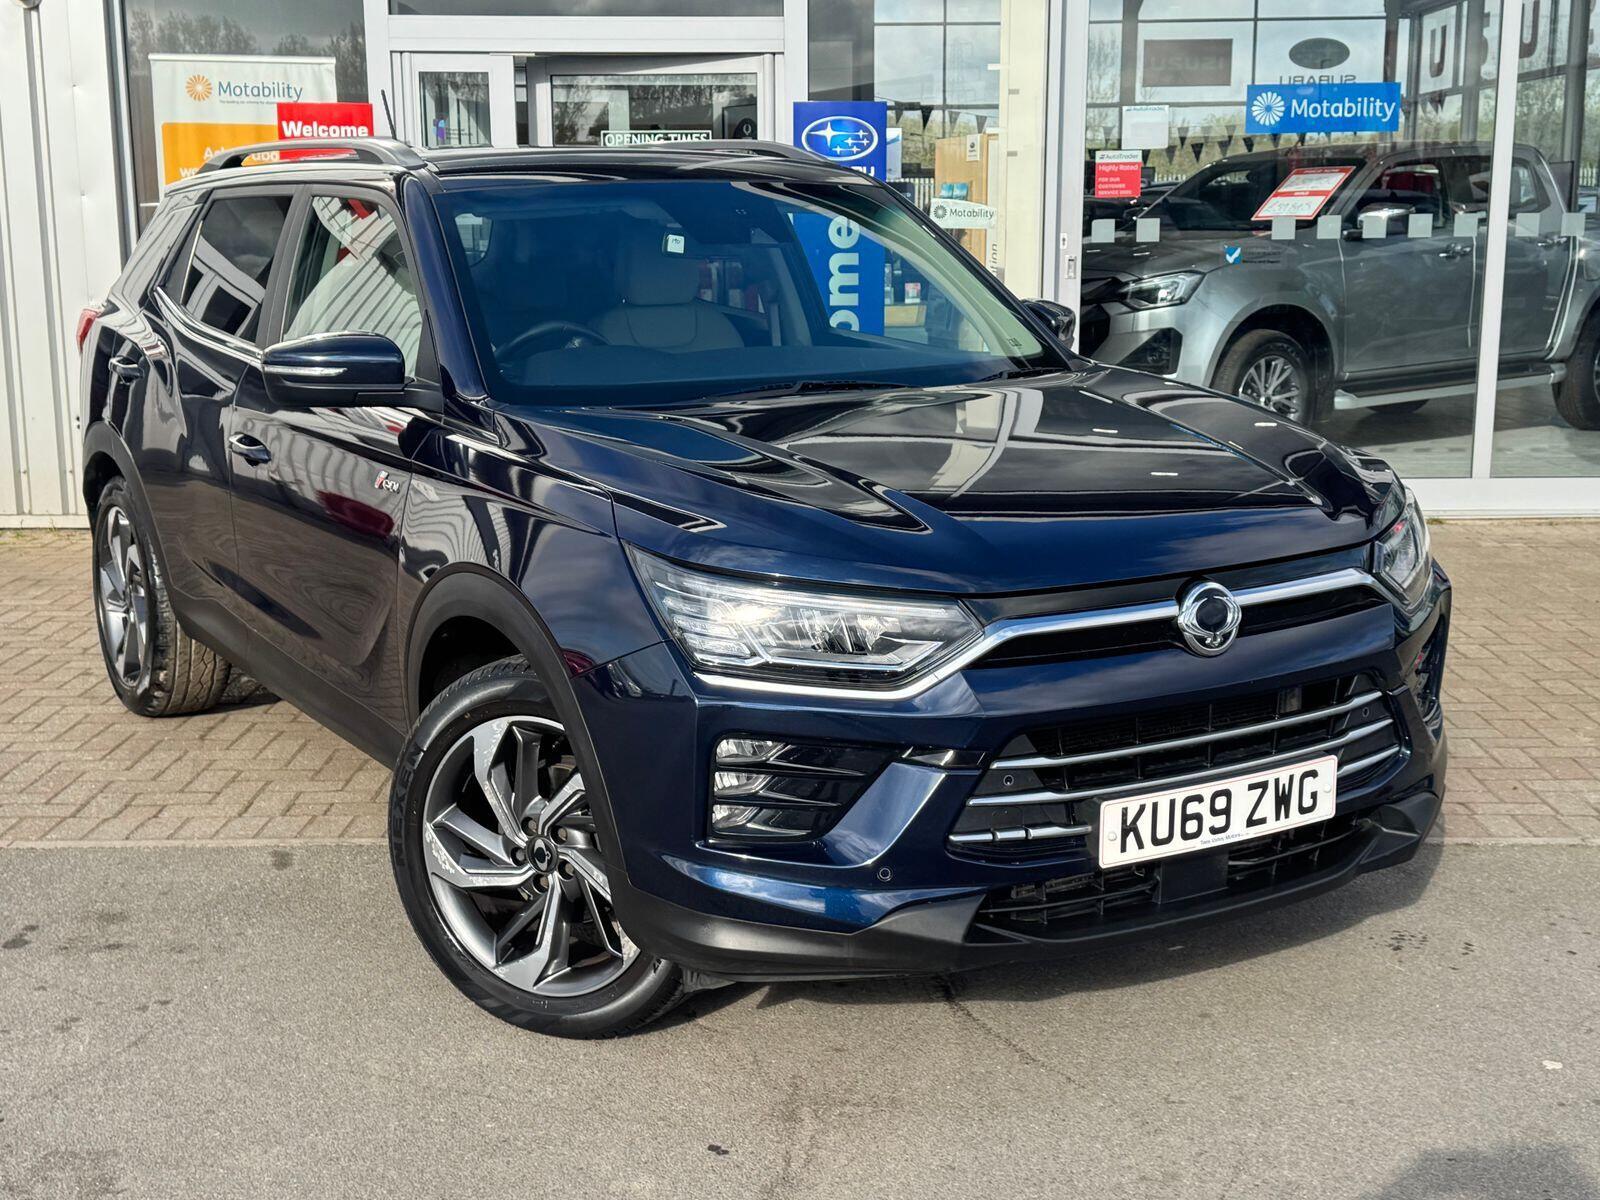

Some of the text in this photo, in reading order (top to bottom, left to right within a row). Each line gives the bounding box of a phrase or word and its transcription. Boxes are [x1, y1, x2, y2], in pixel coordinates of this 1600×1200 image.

[218, 81, 303, 102] Motability
[1290, 97, 1396, 122] Motability
[281, 121, 369, 137] Welcome
[604, 133, 664, 147] OPENING
[949, 207, 994, 219] Motability
[1120, 769, 1319, 853] KU69 ZWG
